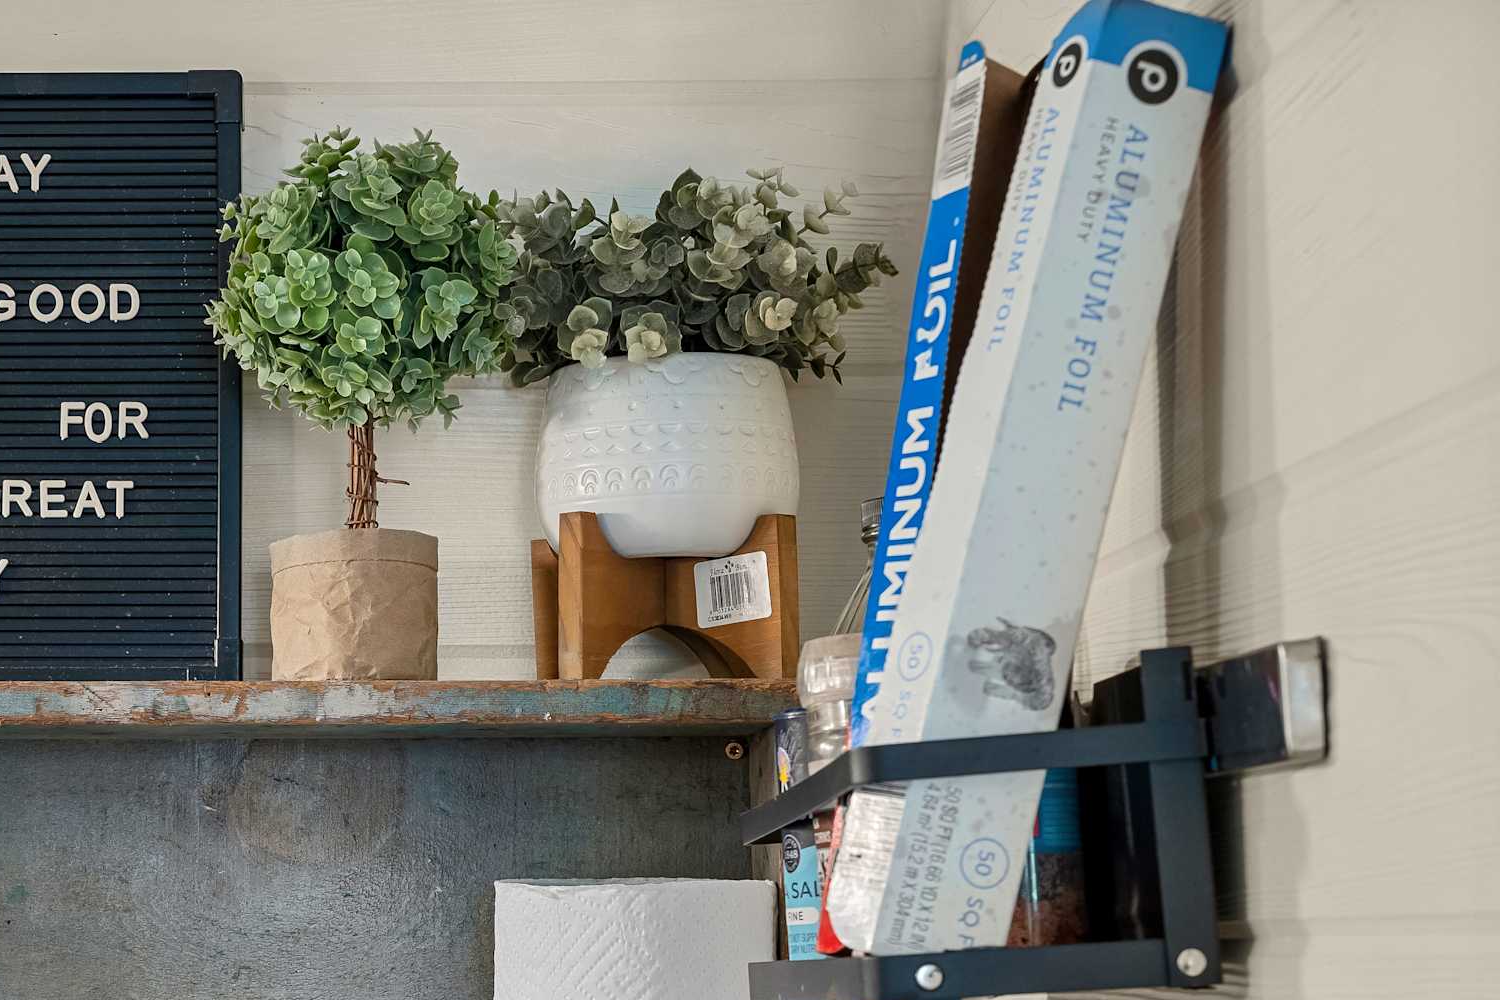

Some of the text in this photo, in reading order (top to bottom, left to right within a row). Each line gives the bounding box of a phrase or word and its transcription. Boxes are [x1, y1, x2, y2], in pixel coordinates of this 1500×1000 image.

[1010, 107, 1045, 212] HEAVY DUTY
[1077, 117, 1120, 243] HEAVY DUTY
[987, 107, 1060, 351] ALUMINUM FOIL
[1056, 124, 1149, 412] ALUMINUM FOIL
[913, 239, 957, 381] FOIL
[60, 402, 148, 443] FOR
[935, 824, 954, 841] FT
[974, 850, 995, 877] 50
[958, 896, 985, 928] SQ
